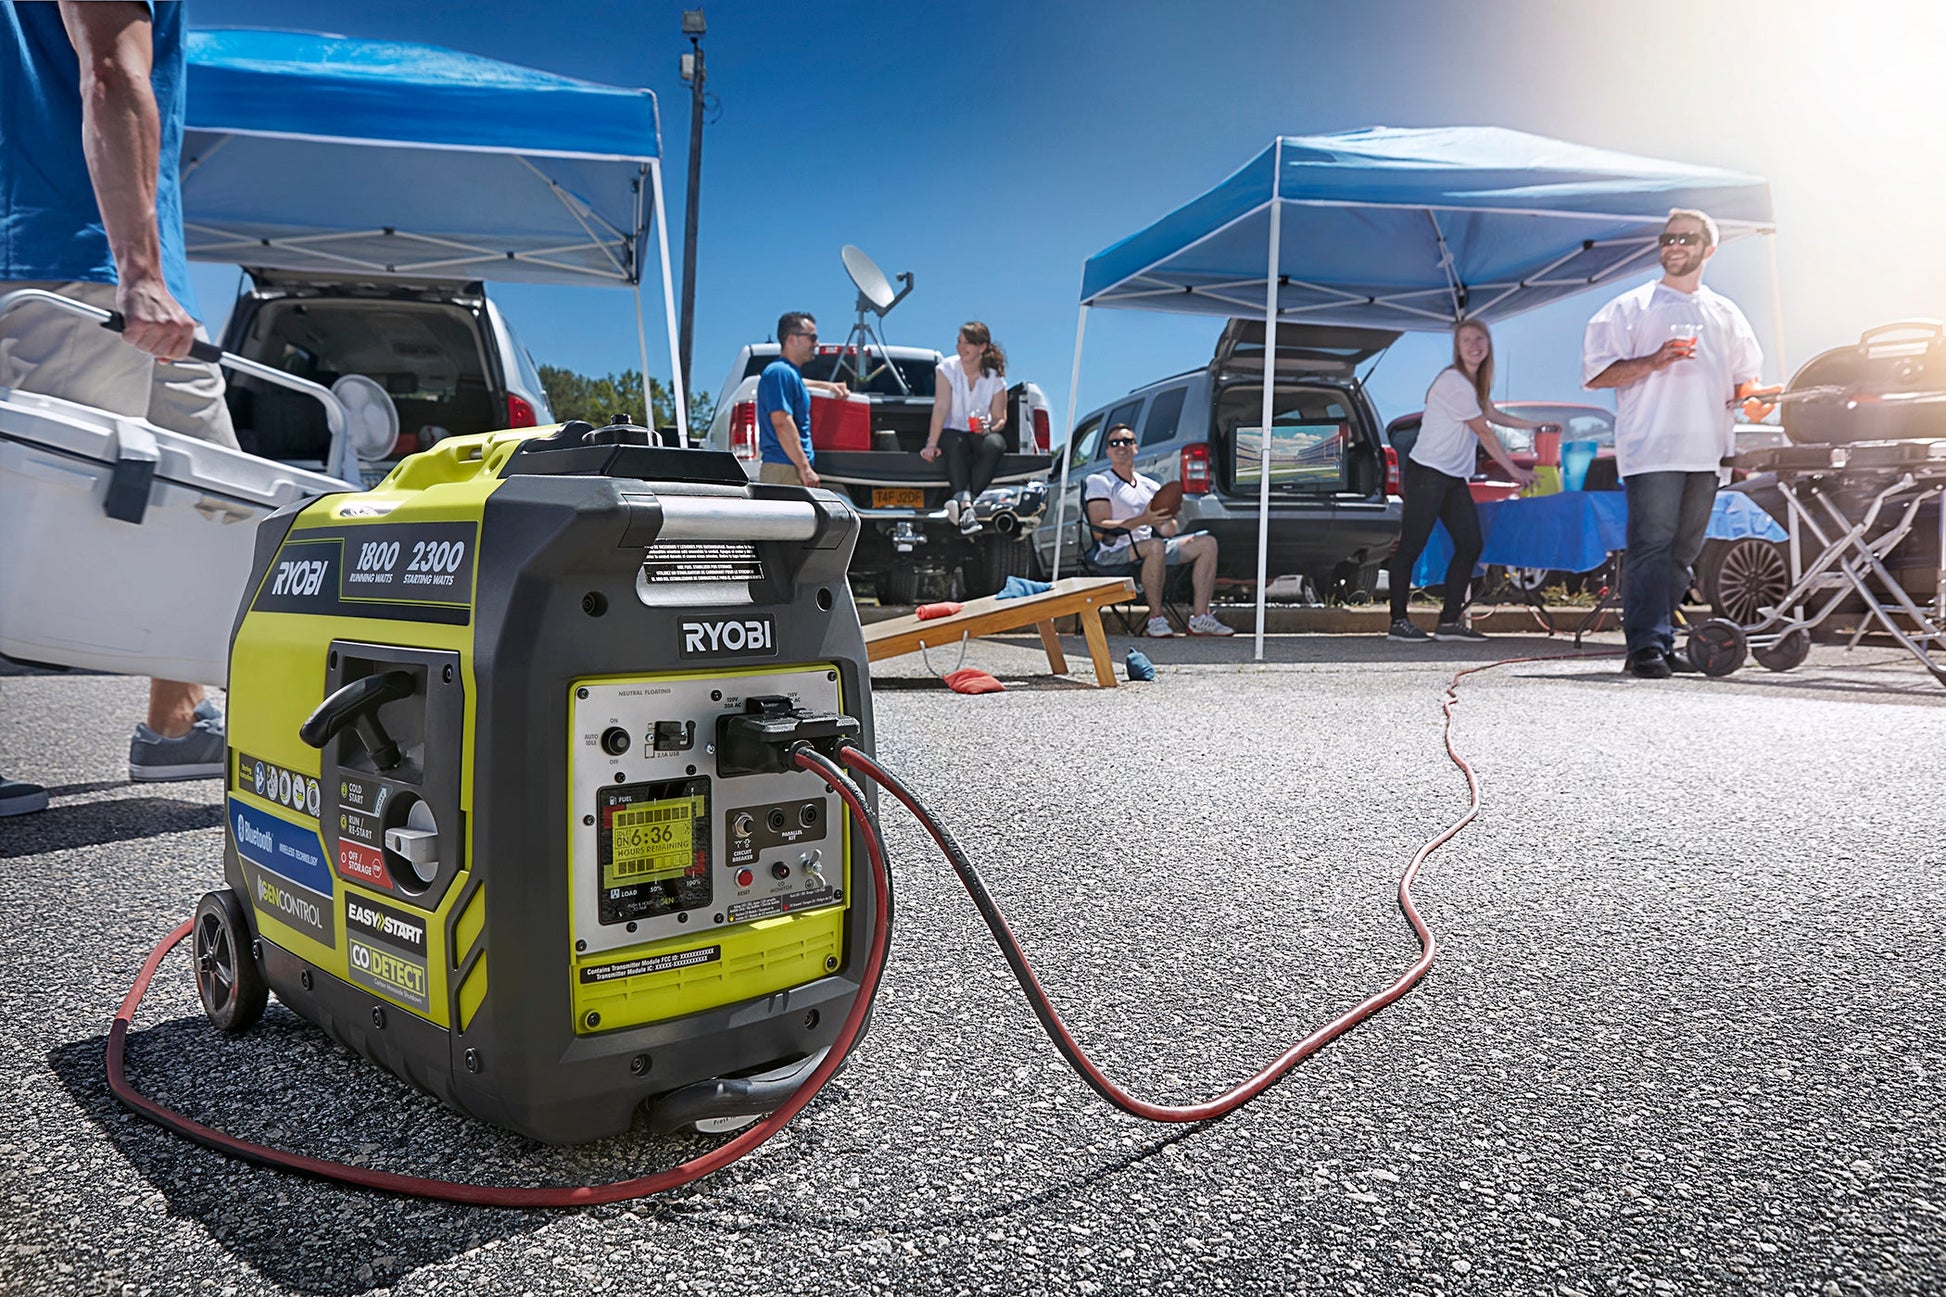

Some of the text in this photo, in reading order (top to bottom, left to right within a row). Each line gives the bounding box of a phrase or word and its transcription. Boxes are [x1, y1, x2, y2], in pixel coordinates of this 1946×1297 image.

[356, 541, 465, 573] 1800 2300
[271, 560, 329, 596] RYOBI
[349, 573, 393, 584] RUNNING WATTS
[403, 574, 454, 586] STARTING WATTS
[682, 620, 772, 653] RYOBI
[348, 783, 363, 794] COLD
[348, 793, 364, 804] START
[348, 815, 360, 827] RUN
[244, 820, 273, 853] Bluetooth
[348, 824, 373, 840] RE-START
[631, 825, 673, 847] 6:36
[781, 829, 803, 838] PARALLEL
[616, 837, 629, 848] ON
[617, 841, 689, 858] HOURS REMAINING
[279, 842, 318, 866] WIRELESS TECHNOLOGY
[348, 851, 359, 861] OFF
[732, 854, 753, 863] BREAKER
[733, 849, 752, 857] CIRCUIT
[348, 860, 372, 876] STORAGE
[621, 890, 638, 898] LOAD
[650, 885, 663, 893] 50%
[348, 903, 423, 944] EASY START
[352, 944, 422, 991] CO DETECT
[586, 966, 611, 976] Contains
[611, 961, 641, 972] Transmitter
[641, 958, 660, 967] Module
[661, 955, 671, 964] FCC
[596, 970, 626, 980] Transmitter
[627, 966, 646, 976] Module
